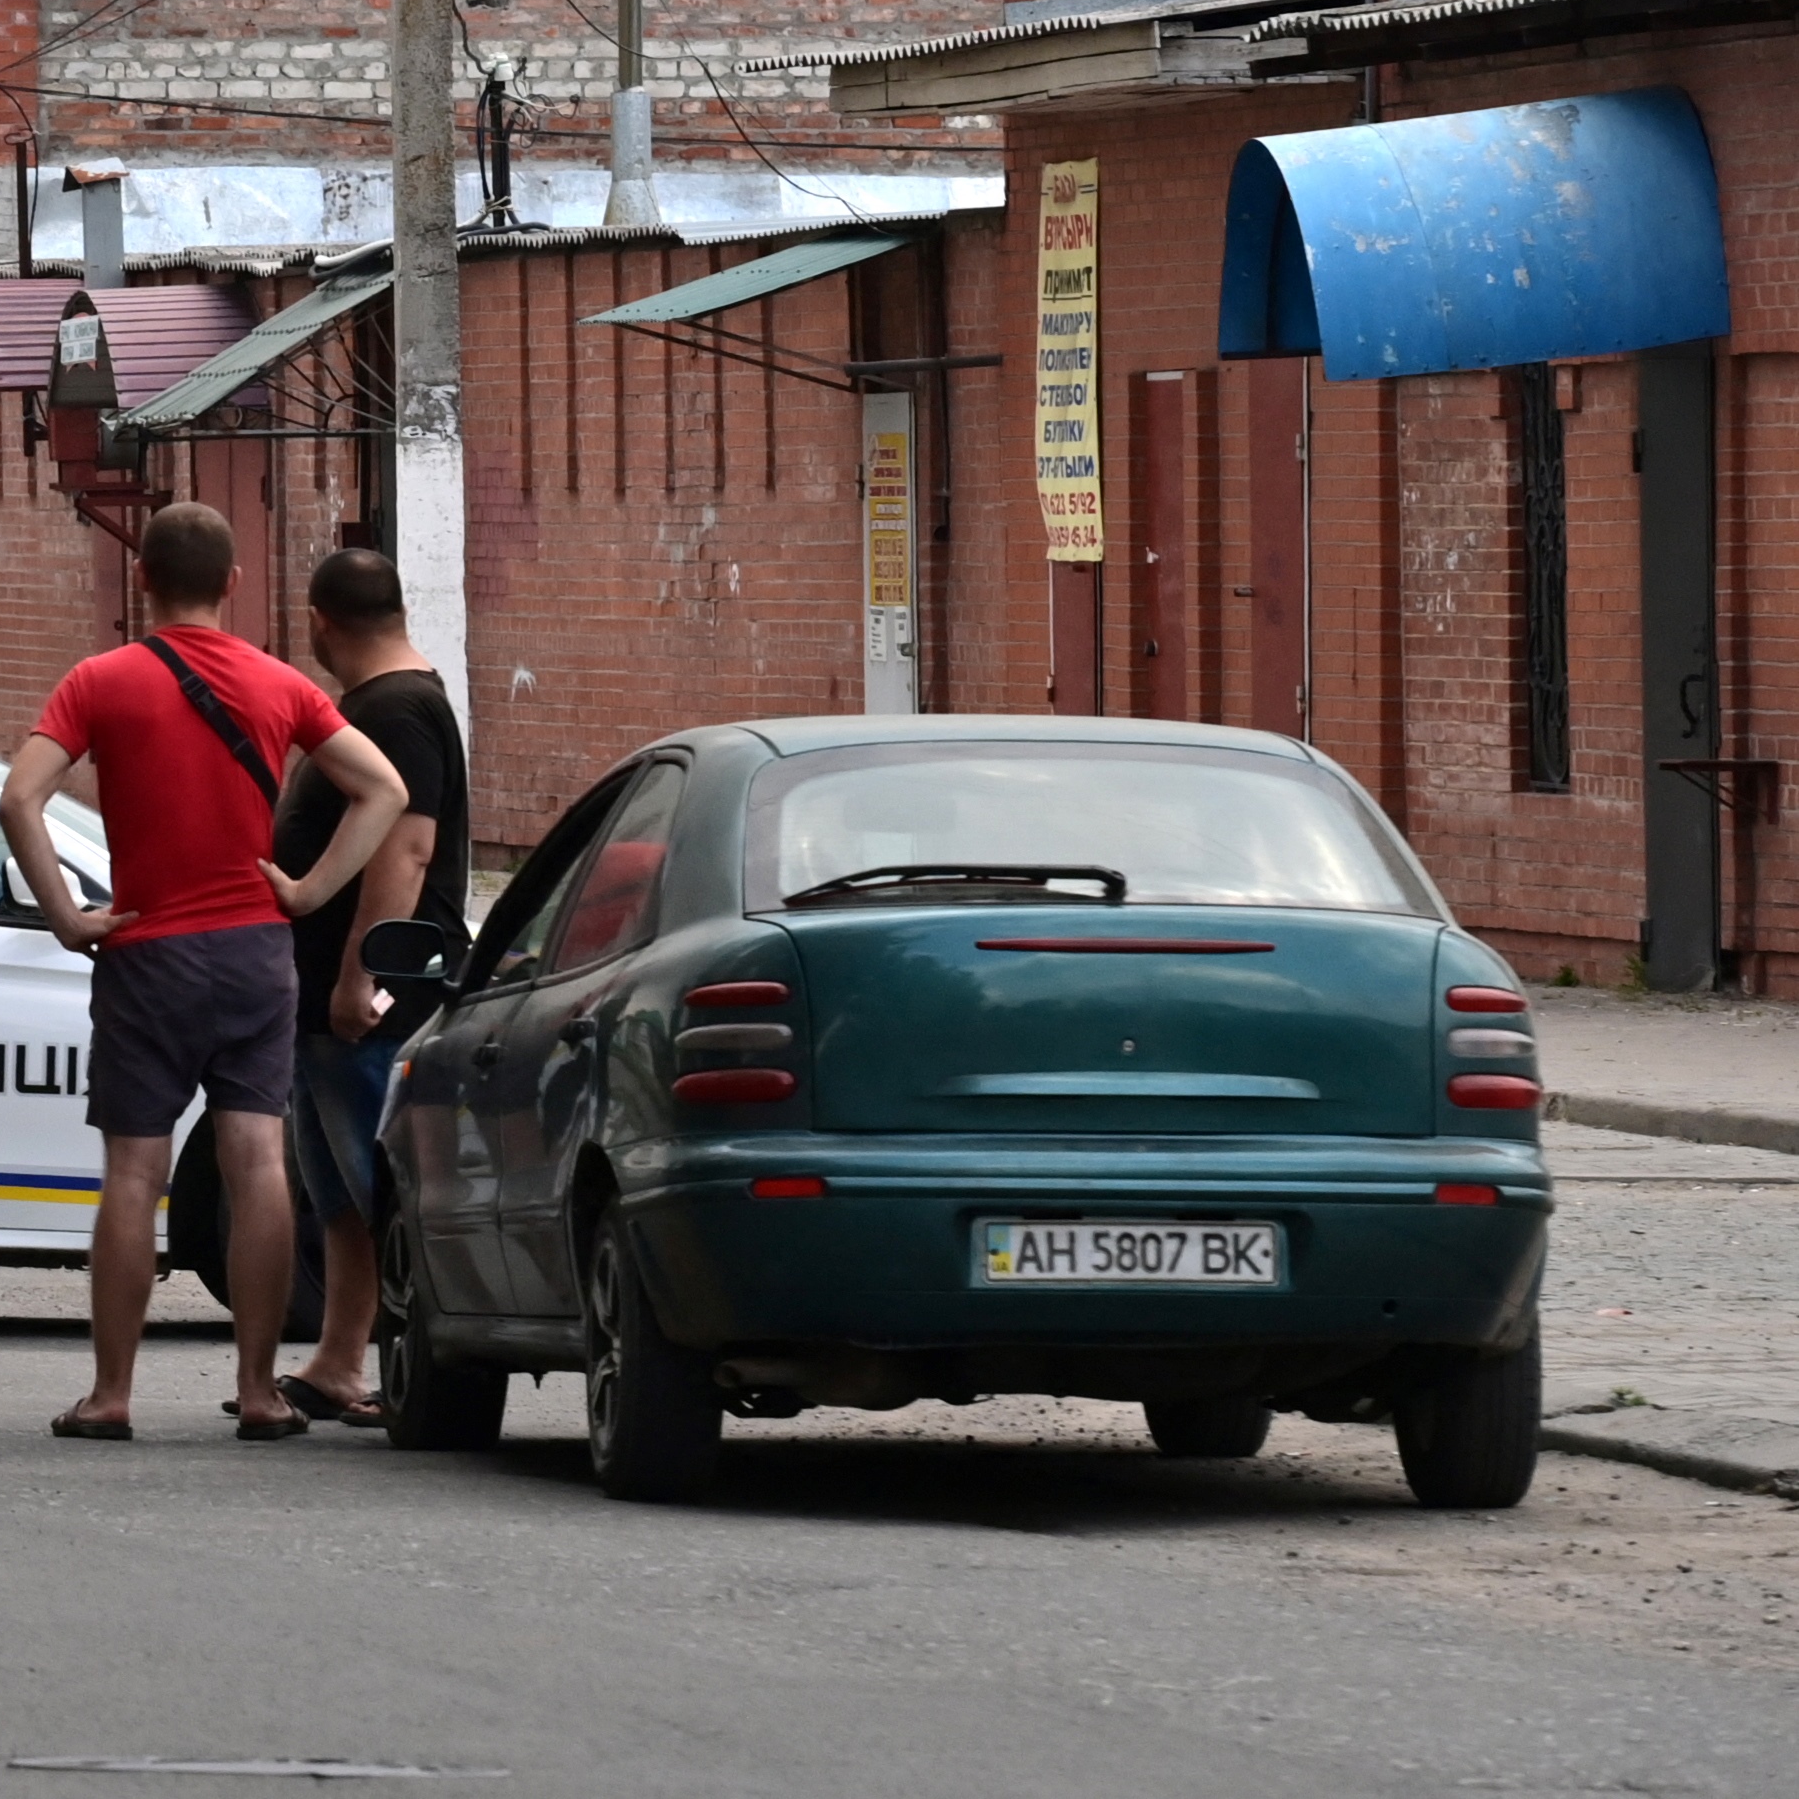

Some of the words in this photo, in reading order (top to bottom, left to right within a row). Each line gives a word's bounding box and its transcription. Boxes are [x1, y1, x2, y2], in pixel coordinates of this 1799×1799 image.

[1015, 1230, 1078, 1274] AH
[1091, 1231, 1188, 1274] 5807
[1201, 1232, 1263, 1275] BK
